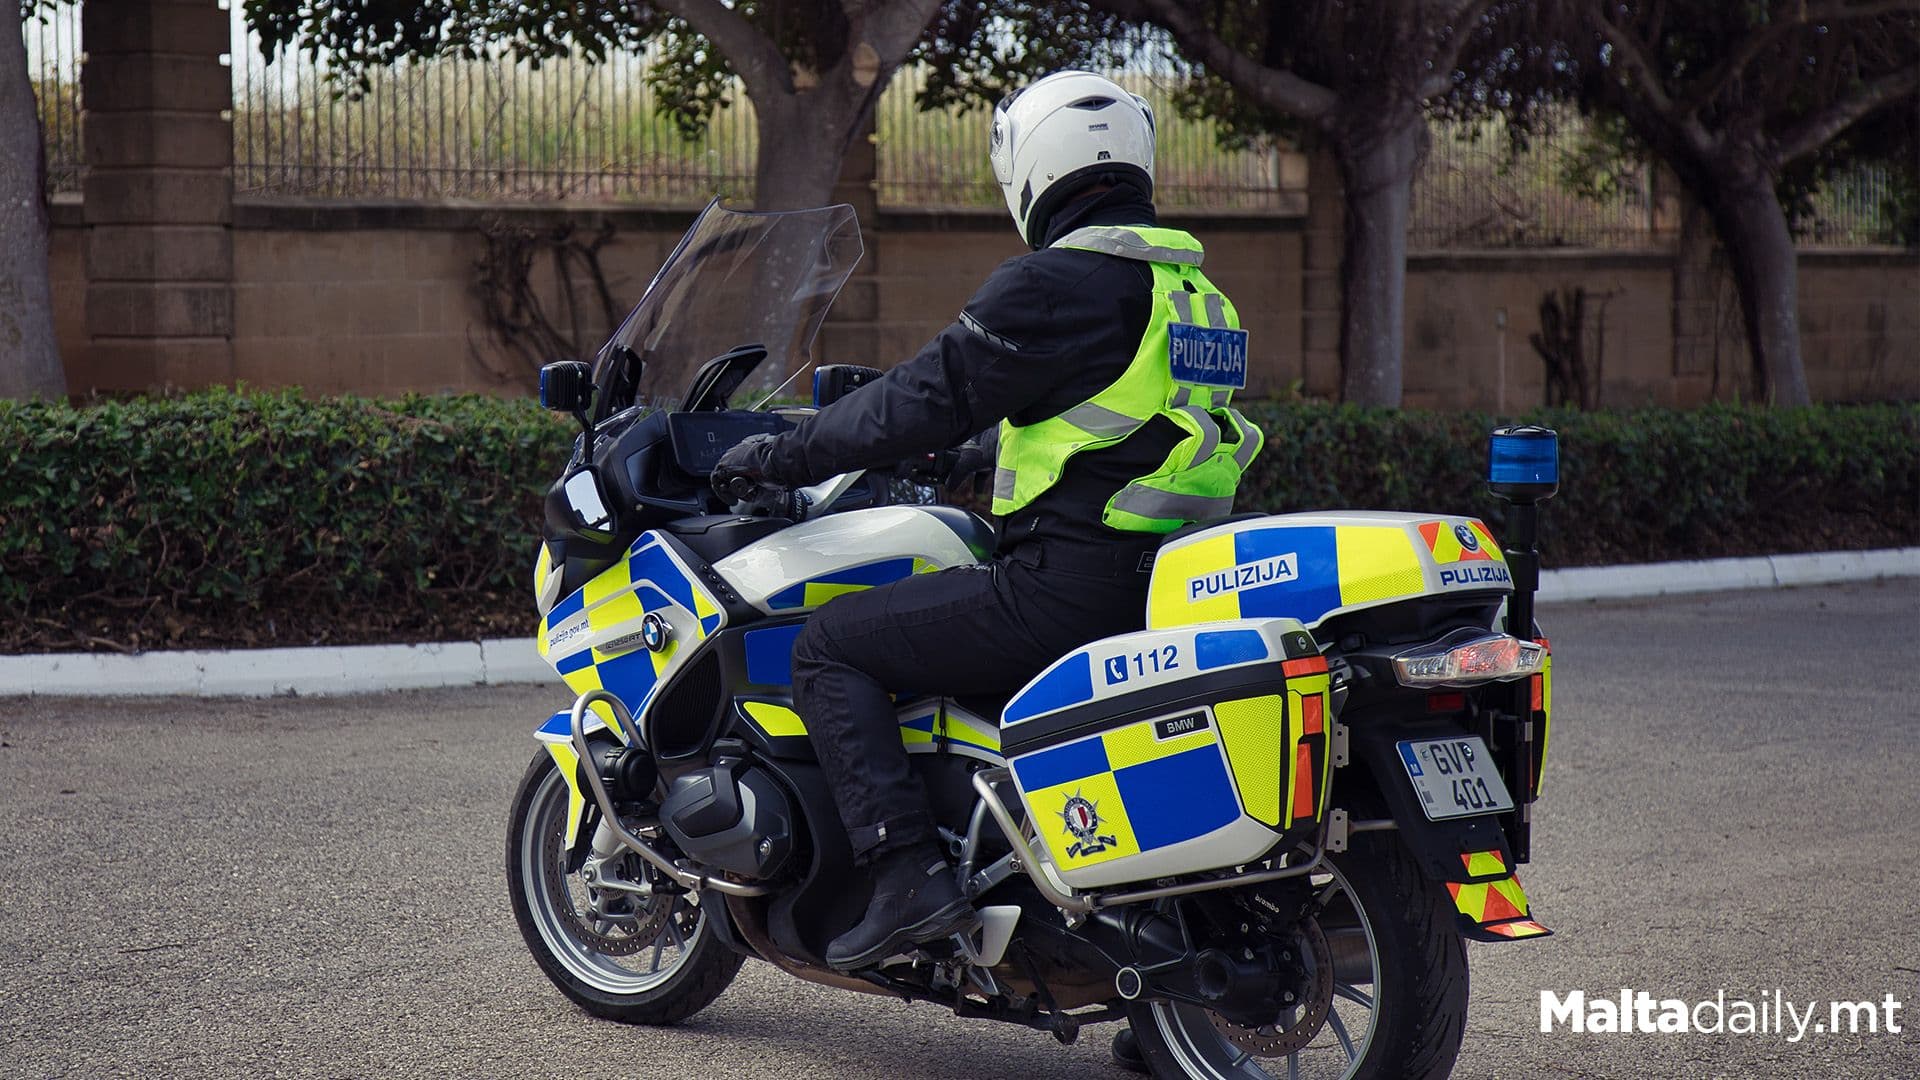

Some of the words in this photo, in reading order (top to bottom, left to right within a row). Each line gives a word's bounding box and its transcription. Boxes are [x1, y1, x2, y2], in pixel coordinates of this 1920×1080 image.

[1172, 337, 1242, 372] PULIZIJA
[1191, 559, 1292, 599] PULIZIJA
[1439, 567, 1511, 586] PULIZIJA
[1133, 645, 1179, 676] 112
[1166, 717, 1195, 734] BMW
[1429, 741, 1475, 775] GVP
[1452, 777, 1498, 811] 401
[1255, 893, 1280, 913] brembo
